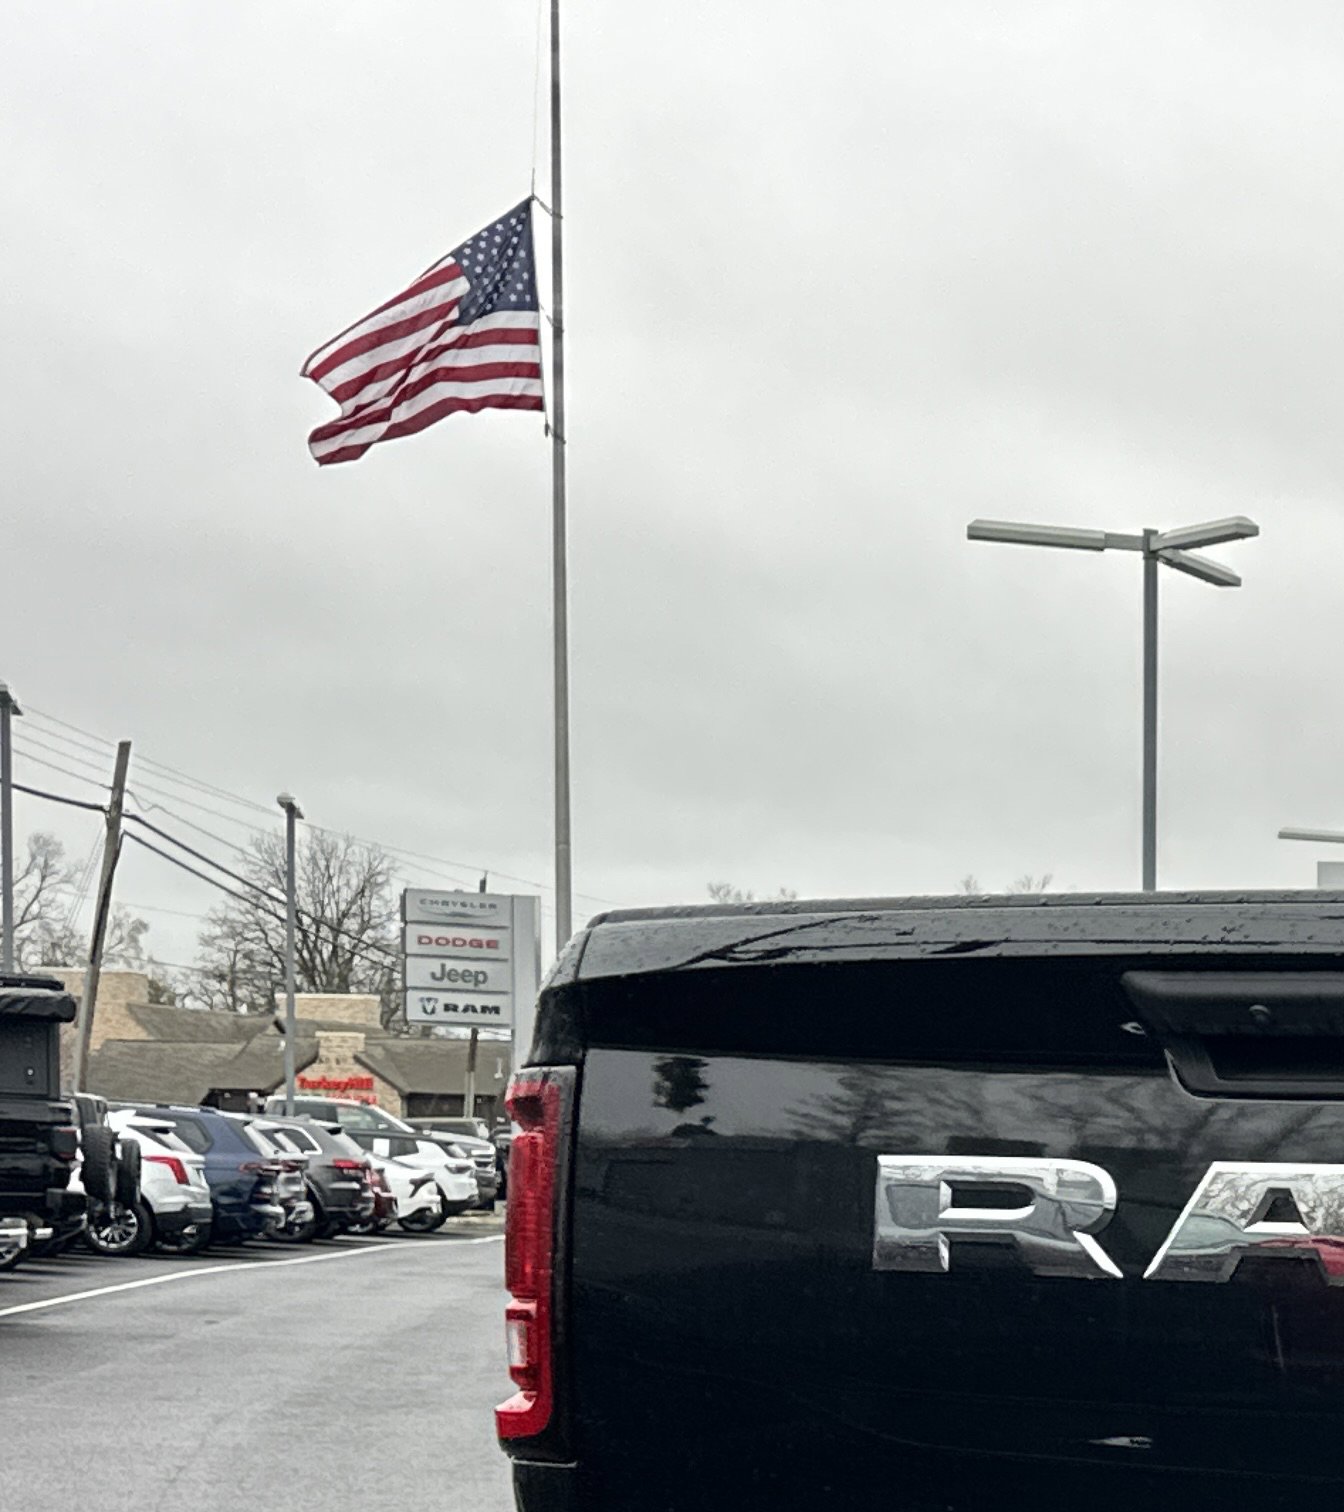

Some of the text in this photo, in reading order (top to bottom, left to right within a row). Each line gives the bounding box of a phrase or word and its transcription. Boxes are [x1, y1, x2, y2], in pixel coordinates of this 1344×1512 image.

[419, 898, 497, 909] CHRYSLER
[417, 935, 498, 949] DODGE
[430, 963, 488, 987] Jeep
[443, 1003, 501, 1015] RAM
